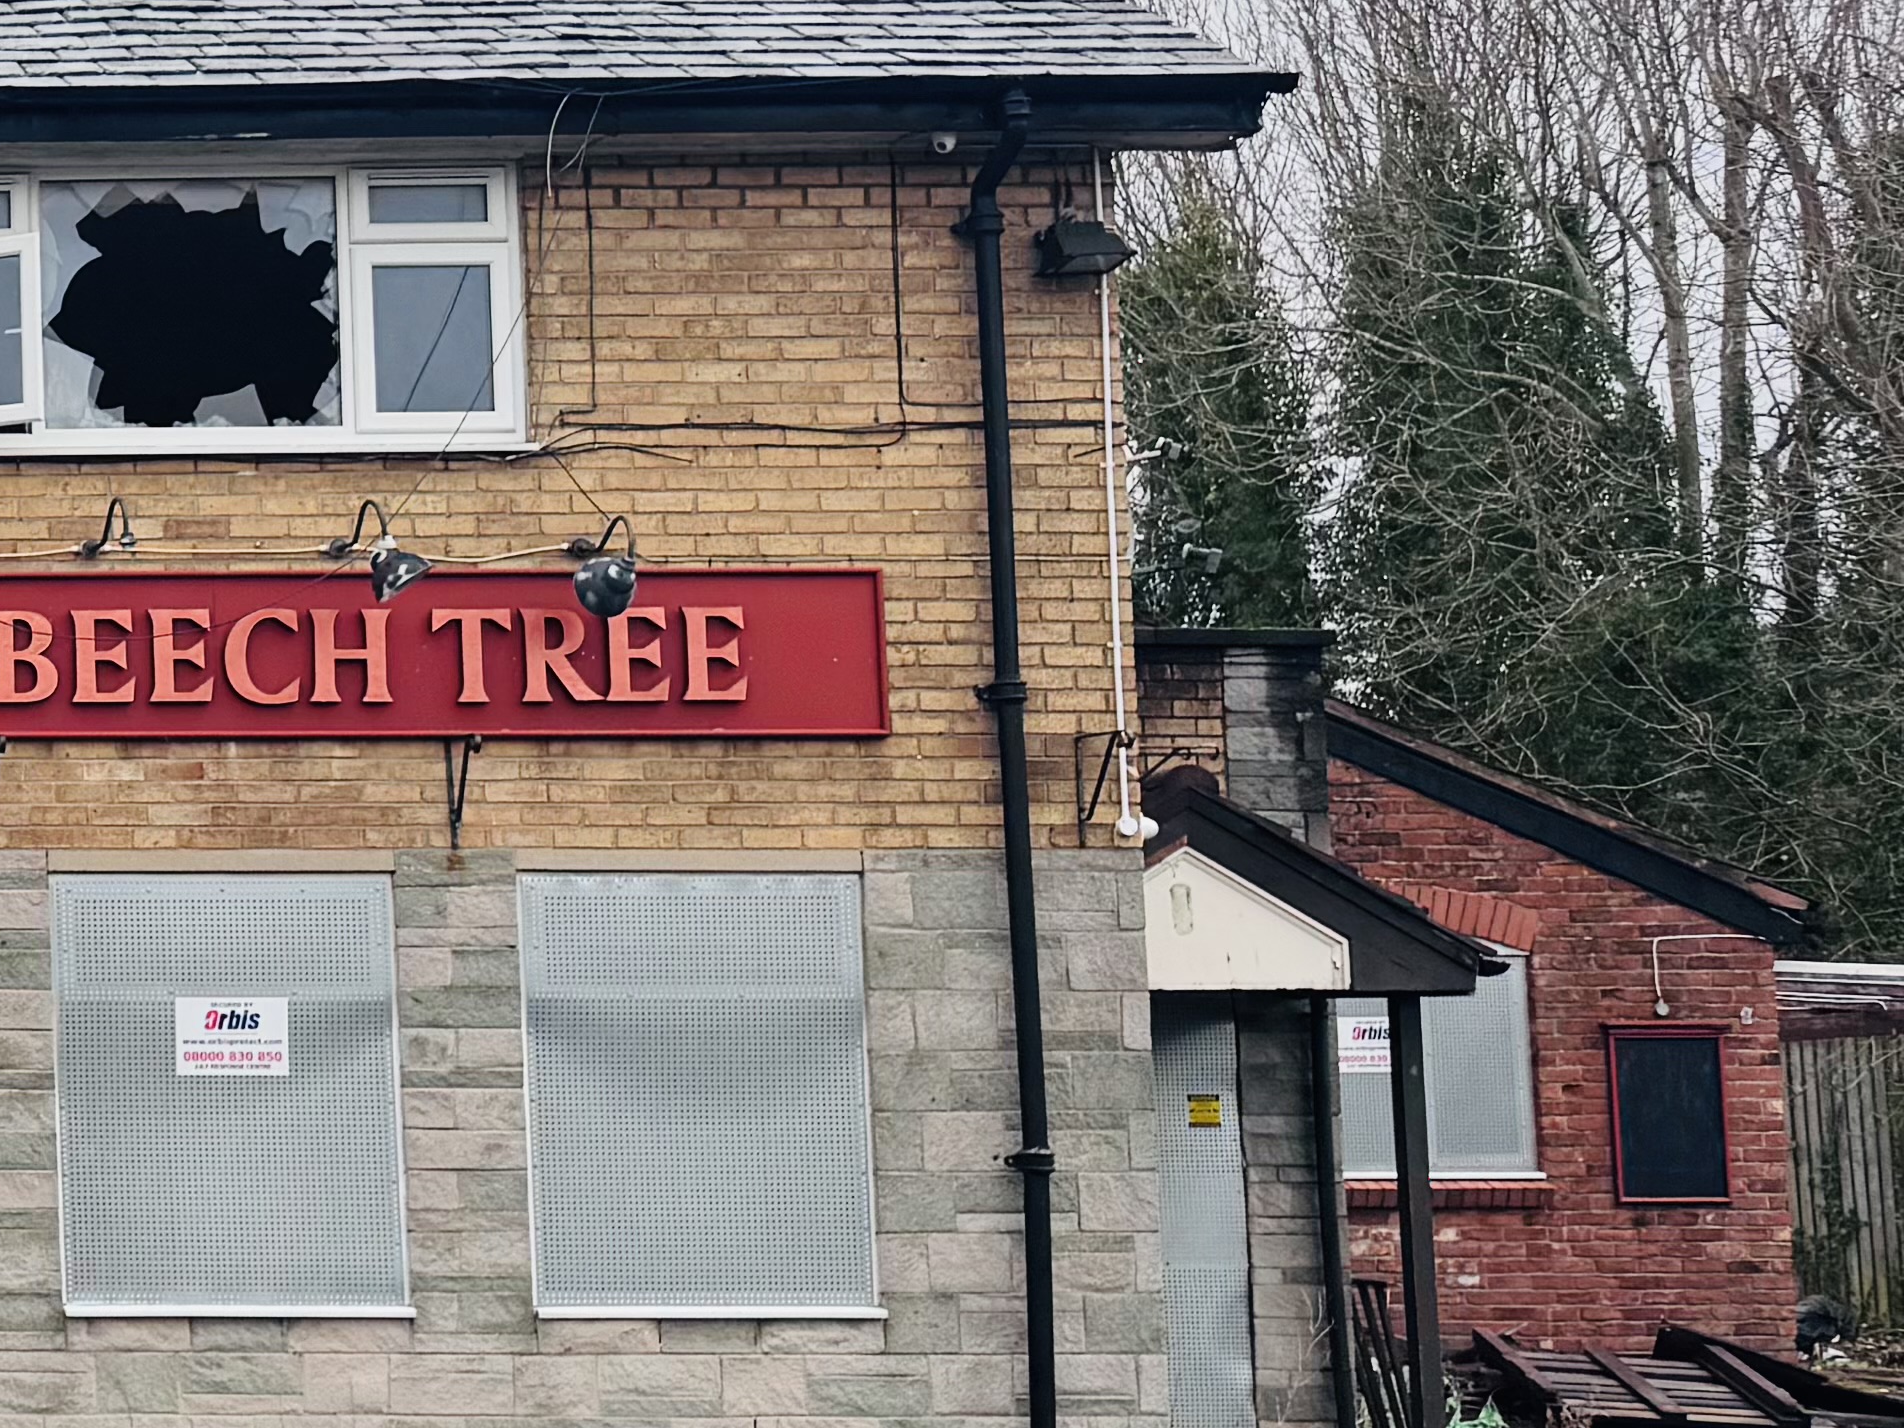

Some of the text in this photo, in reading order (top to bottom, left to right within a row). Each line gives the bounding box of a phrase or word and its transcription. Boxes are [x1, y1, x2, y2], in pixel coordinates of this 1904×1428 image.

[430, 605, 749, 703] TREE
[204, 1010, 260, 1030] Orbis
[1352, 1025, 1390, 1041] Orbis
[183, 1051, 282, 1062] 08000 830 850
